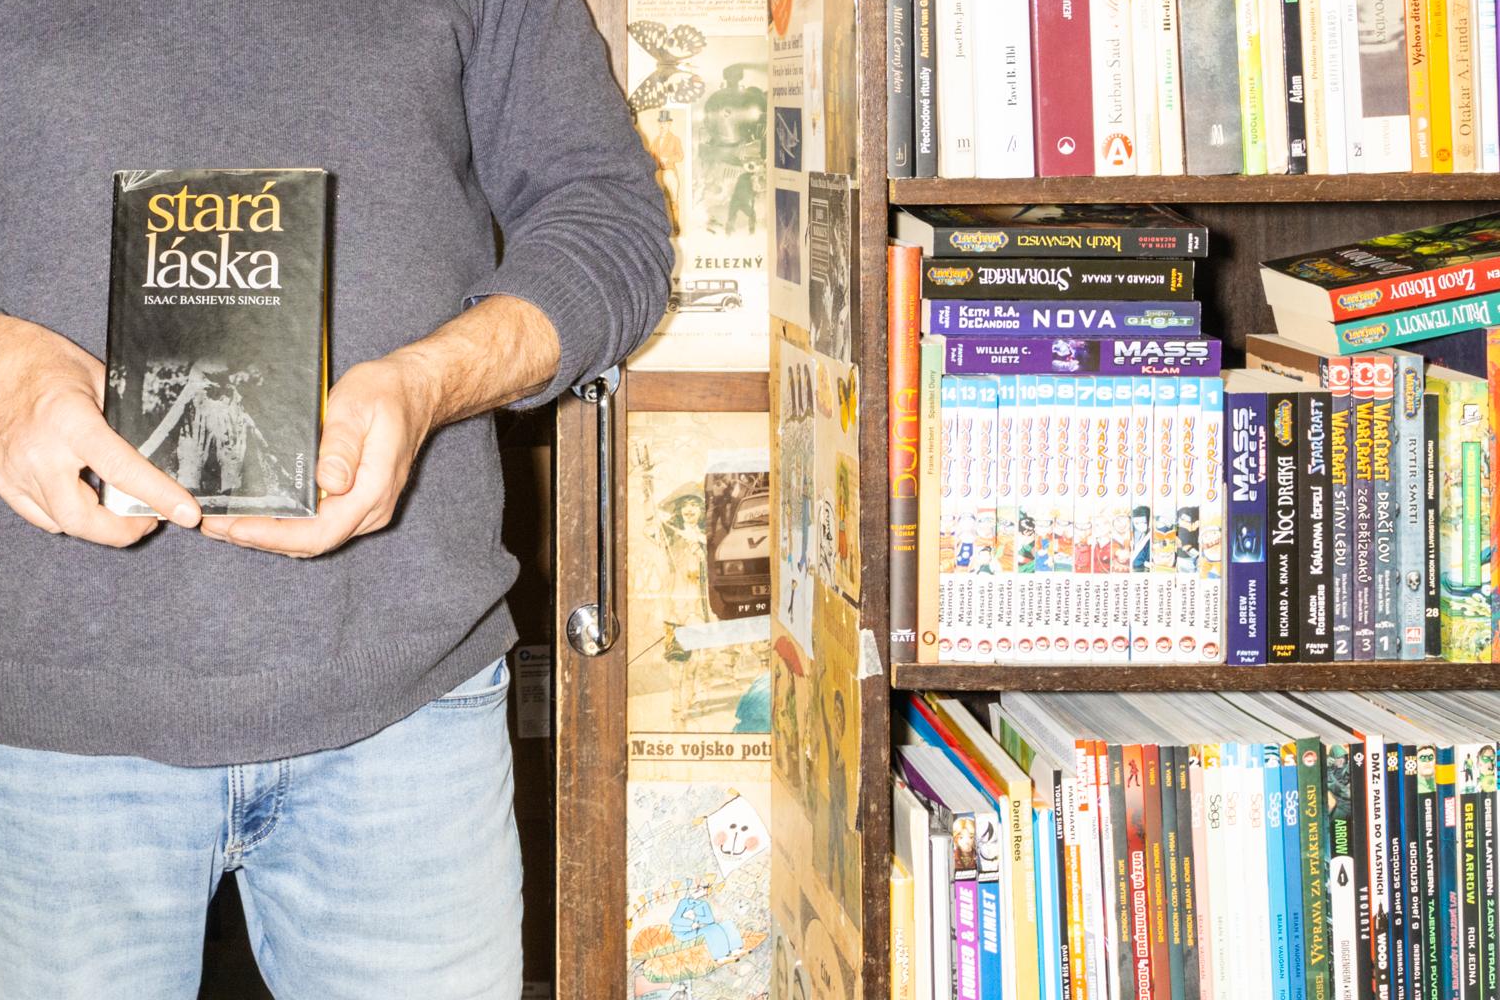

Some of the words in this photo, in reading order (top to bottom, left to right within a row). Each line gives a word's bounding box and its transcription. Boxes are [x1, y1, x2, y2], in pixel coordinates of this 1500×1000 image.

[147, 181, 283, 231] stará
[142, 233, 282, 289] láska
[695, 256, 763, 269] ŽELEZNÝ
[144, 296, 178, 305] ISAAC
[180, 296, 236, 305] BASHEVIS
[238, 296, 280, 305] SINGER
[994, 308, 1020, 317] R.A.
[1032, 309, 1116, 329] NOVA
[1114, 342, 1208, 355] MASS
[1114, 357, 1210, 366] EFFECT
[1141, 366, 1180, 375] KLAM
[1210, 423, 1220, 502] NARUTO
[1275, 456, 1295, 507] DRAKA
[1273, 509, 1294, 545] NOC
[681, 740, 734, 759] vojsko
[1335, 819, 1346, 856] ARROW
[1464, 803, 1474, 845] GREEN
[1309, 881, 1320, 897] ZA
[1464, 849, 1475, 904] ARROW
[982, 892, 998, 954] HAMLET
